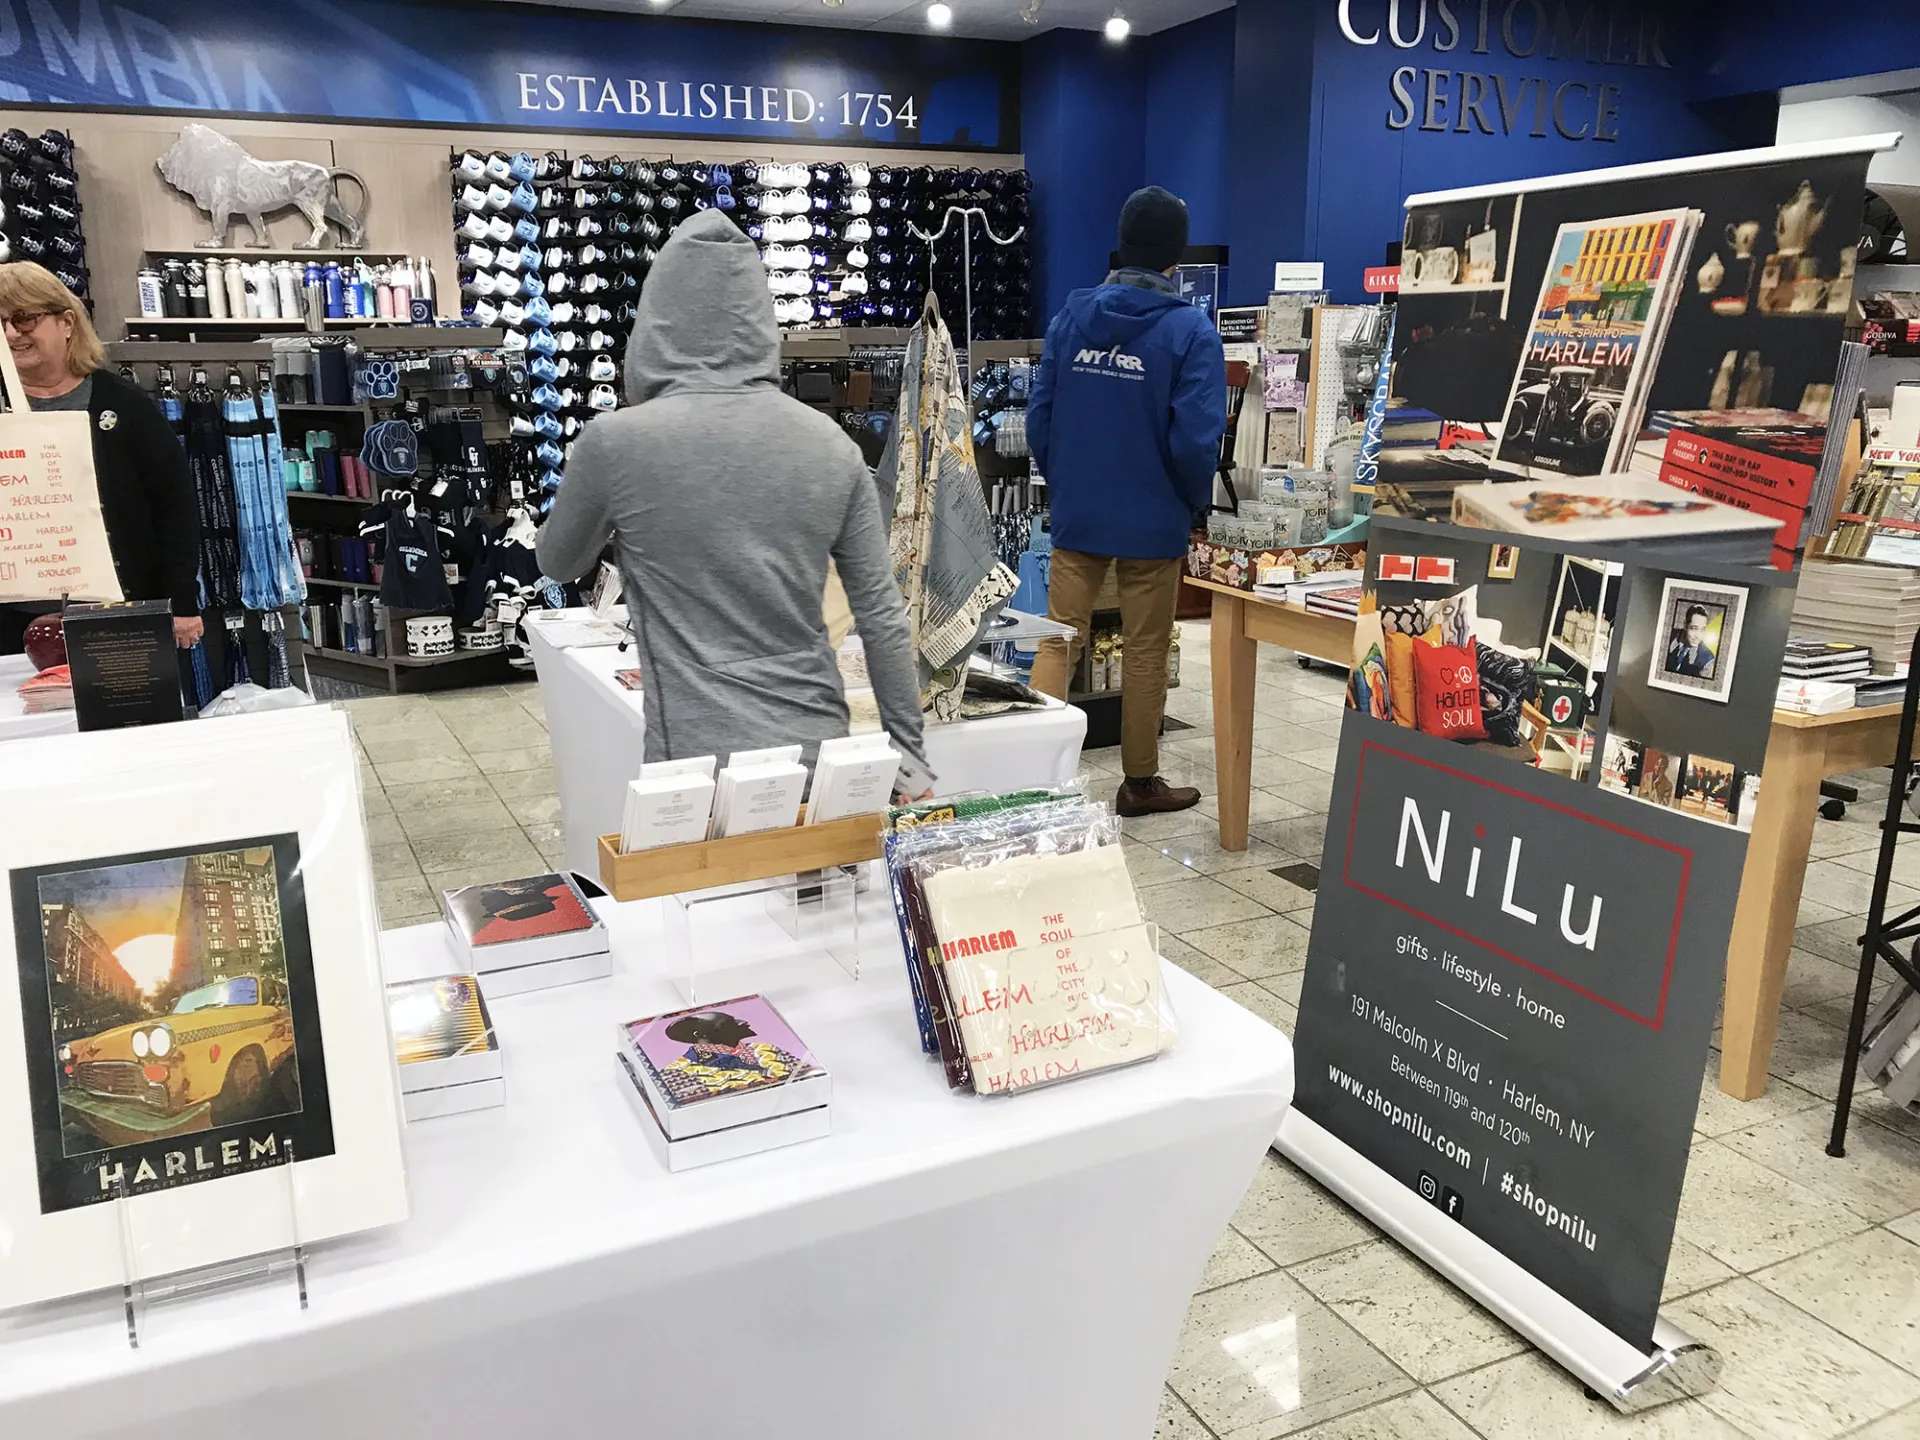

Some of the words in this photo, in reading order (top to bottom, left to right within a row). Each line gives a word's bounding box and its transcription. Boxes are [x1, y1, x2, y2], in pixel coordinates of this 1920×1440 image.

[1337, 0, 1673, 69] CUSTOMER
[516, 72, 826, 124] ESTABLISHED:
[837, 90, 919, 129] 1754
[1385, 66, 1621, 142] SERVICE
[1557, 328, 1575, 338] THE
[1576, 328, 1609, 339] SPIRIT
[1530, 339, 1633, 366] HARLEM
[1086, 367, 1101, 375] YORK
[1868, 449, 1895, 460] NEW
[1442, 708, 1476, 729] SOUL
[1395, 796, 1603, 951] NiLu
[1041, 913, 1065, 926] THE
[941, 929, 1018, 962] HARLEM
[1039, 928, 1075, 945] SOUL
[1056, 947, 1072, 960] OF
[1057, 962, 1079, 975] THE
[1061, 976, 1086, 991] CITY
[1395, 934, 1429, 961] gifts
[1441, 950, 1502, 997] lifestyle
[1515, 987, 1566, 1029] home
[1351, 994, 1370, 1020] 191
[1372, 1006, 1428, 1054] Malcolm
[1431, 1038, 1443, 1063] X
[1446, 1047, 1481, 1084] Blvd
[1502, 1079, 1564, 1136] Harlem,
[1568, 1118, 1595, 1149] NY
[1390, 1054, 1441, 1098] Between
[1444, 1085, 1469, 1109] 119th
[1470, 1104, 1496, 1131] and
[1499, 1118, 1531, 1146] 120th
[100, 1132, 278, 1190] HARLEM
[1328, 1064, 1472, 1170] www.shopnilu.com
[1500, 1171, 1597, 1252] #shopnilu
